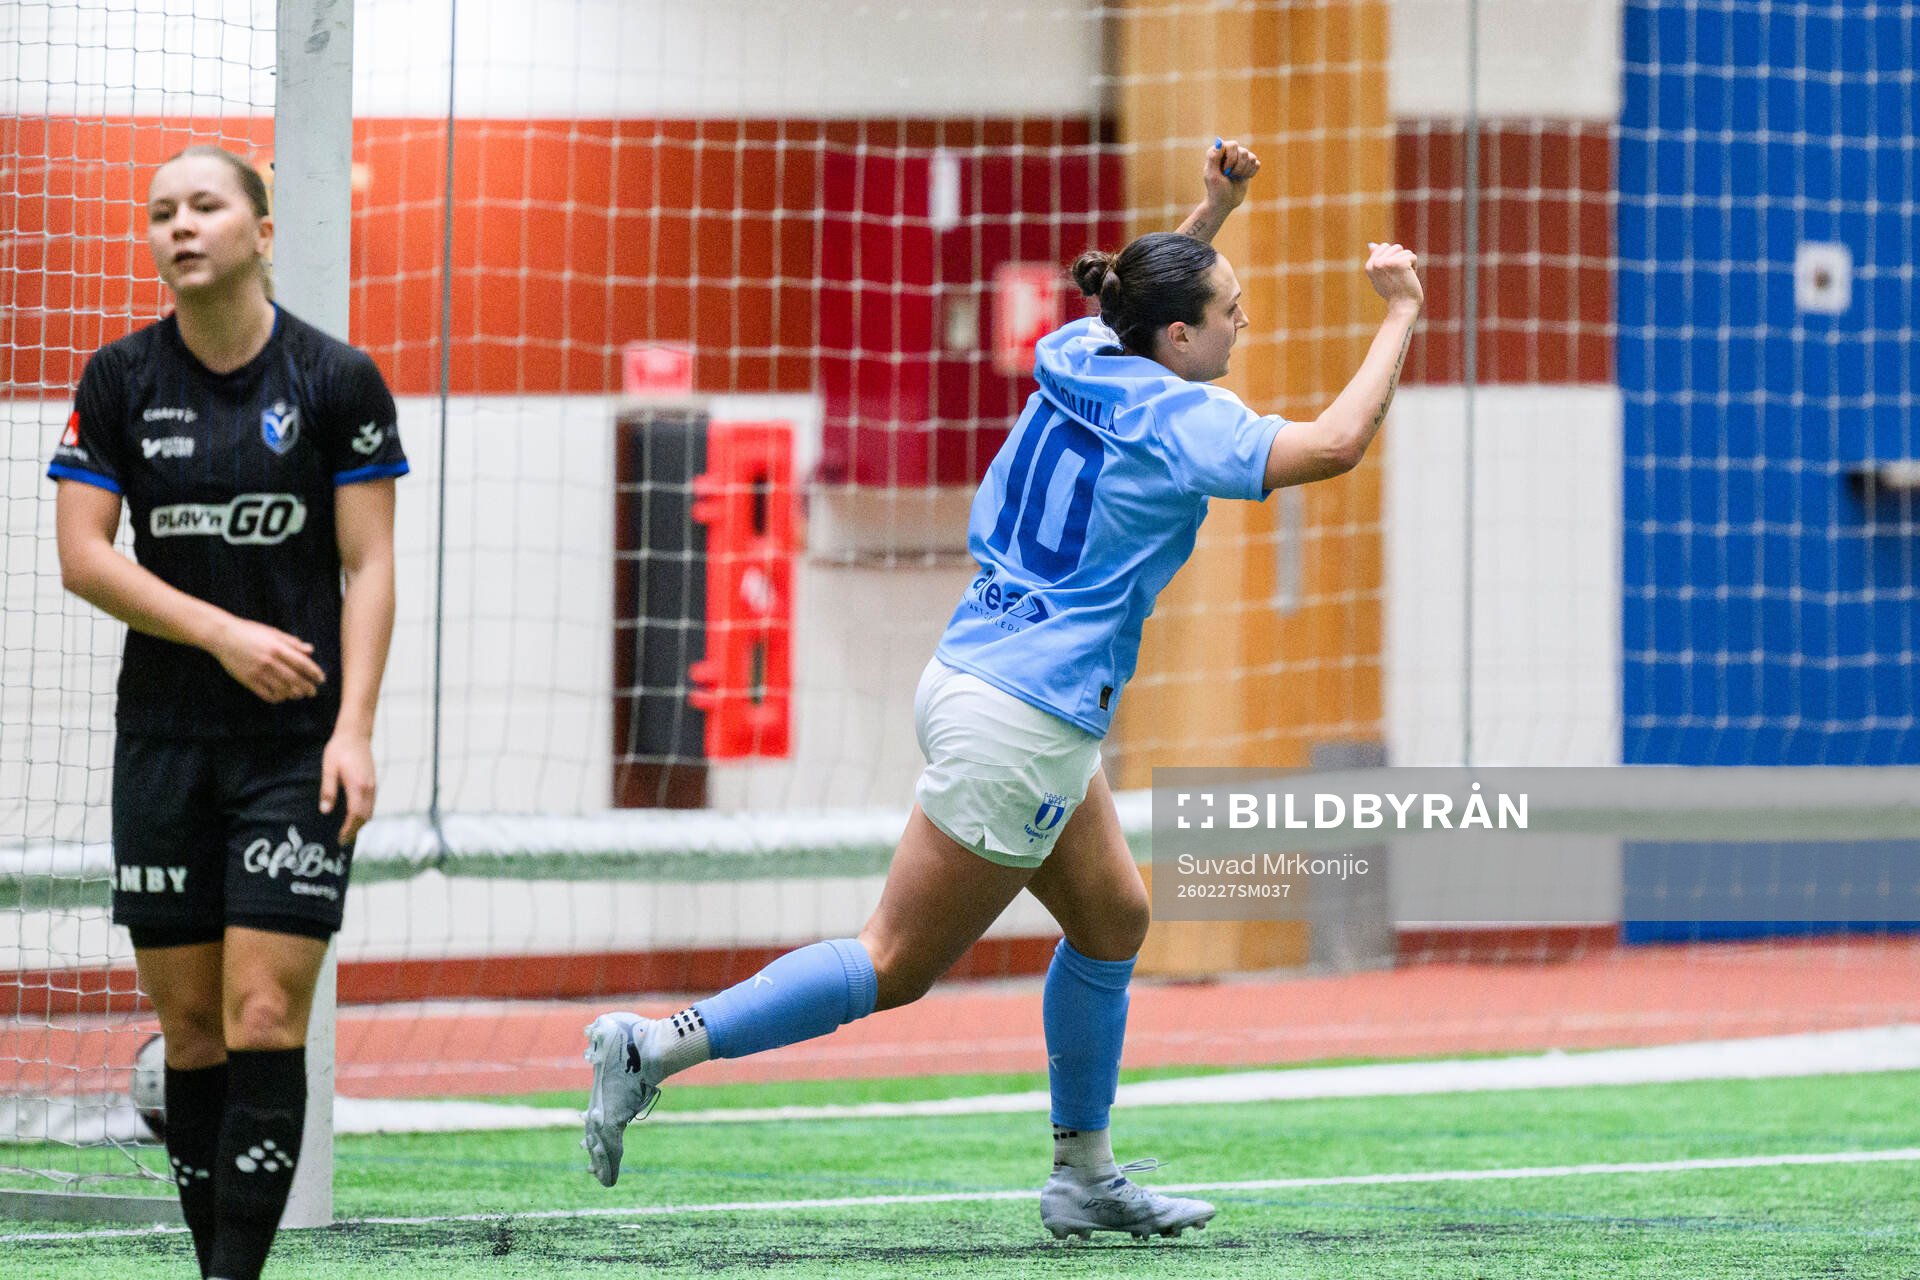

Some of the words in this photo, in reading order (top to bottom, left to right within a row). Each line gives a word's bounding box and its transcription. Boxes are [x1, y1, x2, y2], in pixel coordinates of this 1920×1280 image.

[986, 397, 1105, 584] 10
[228, 500, 294, 538] GO
[112, 865, 188, 893] MBY
